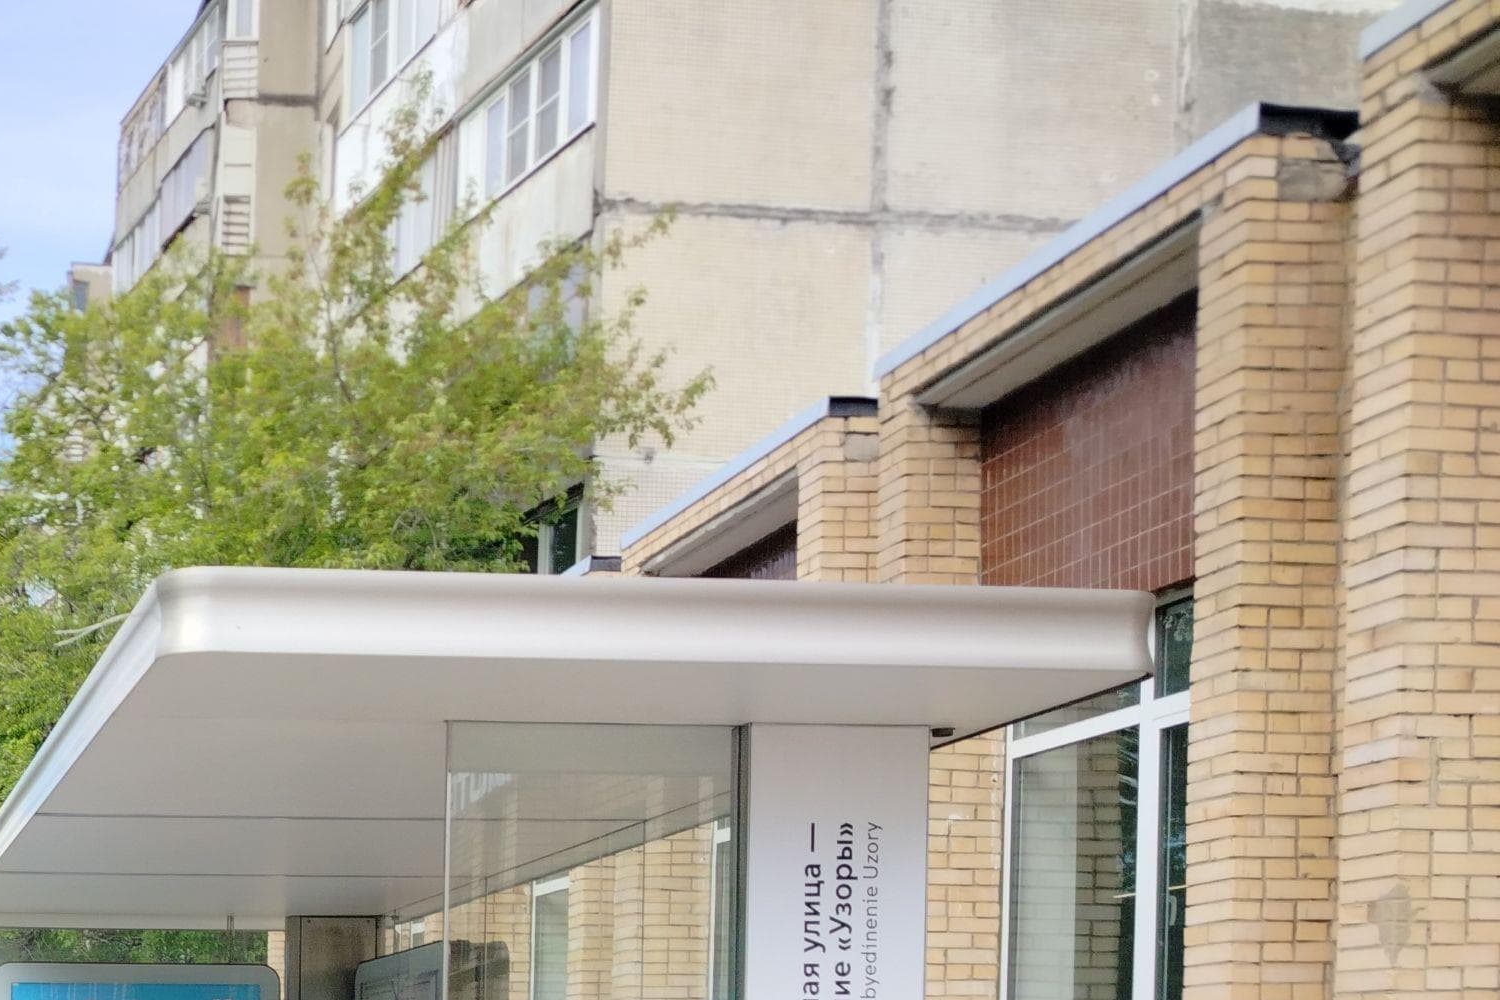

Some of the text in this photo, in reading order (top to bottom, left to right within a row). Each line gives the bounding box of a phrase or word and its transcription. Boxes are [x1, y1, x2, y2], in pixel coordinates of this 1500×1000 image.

[828, 821, 859, 952] «Узоры»
[862, 821, 884, 880] Uzory
[803, 863, 827, 954] улица
